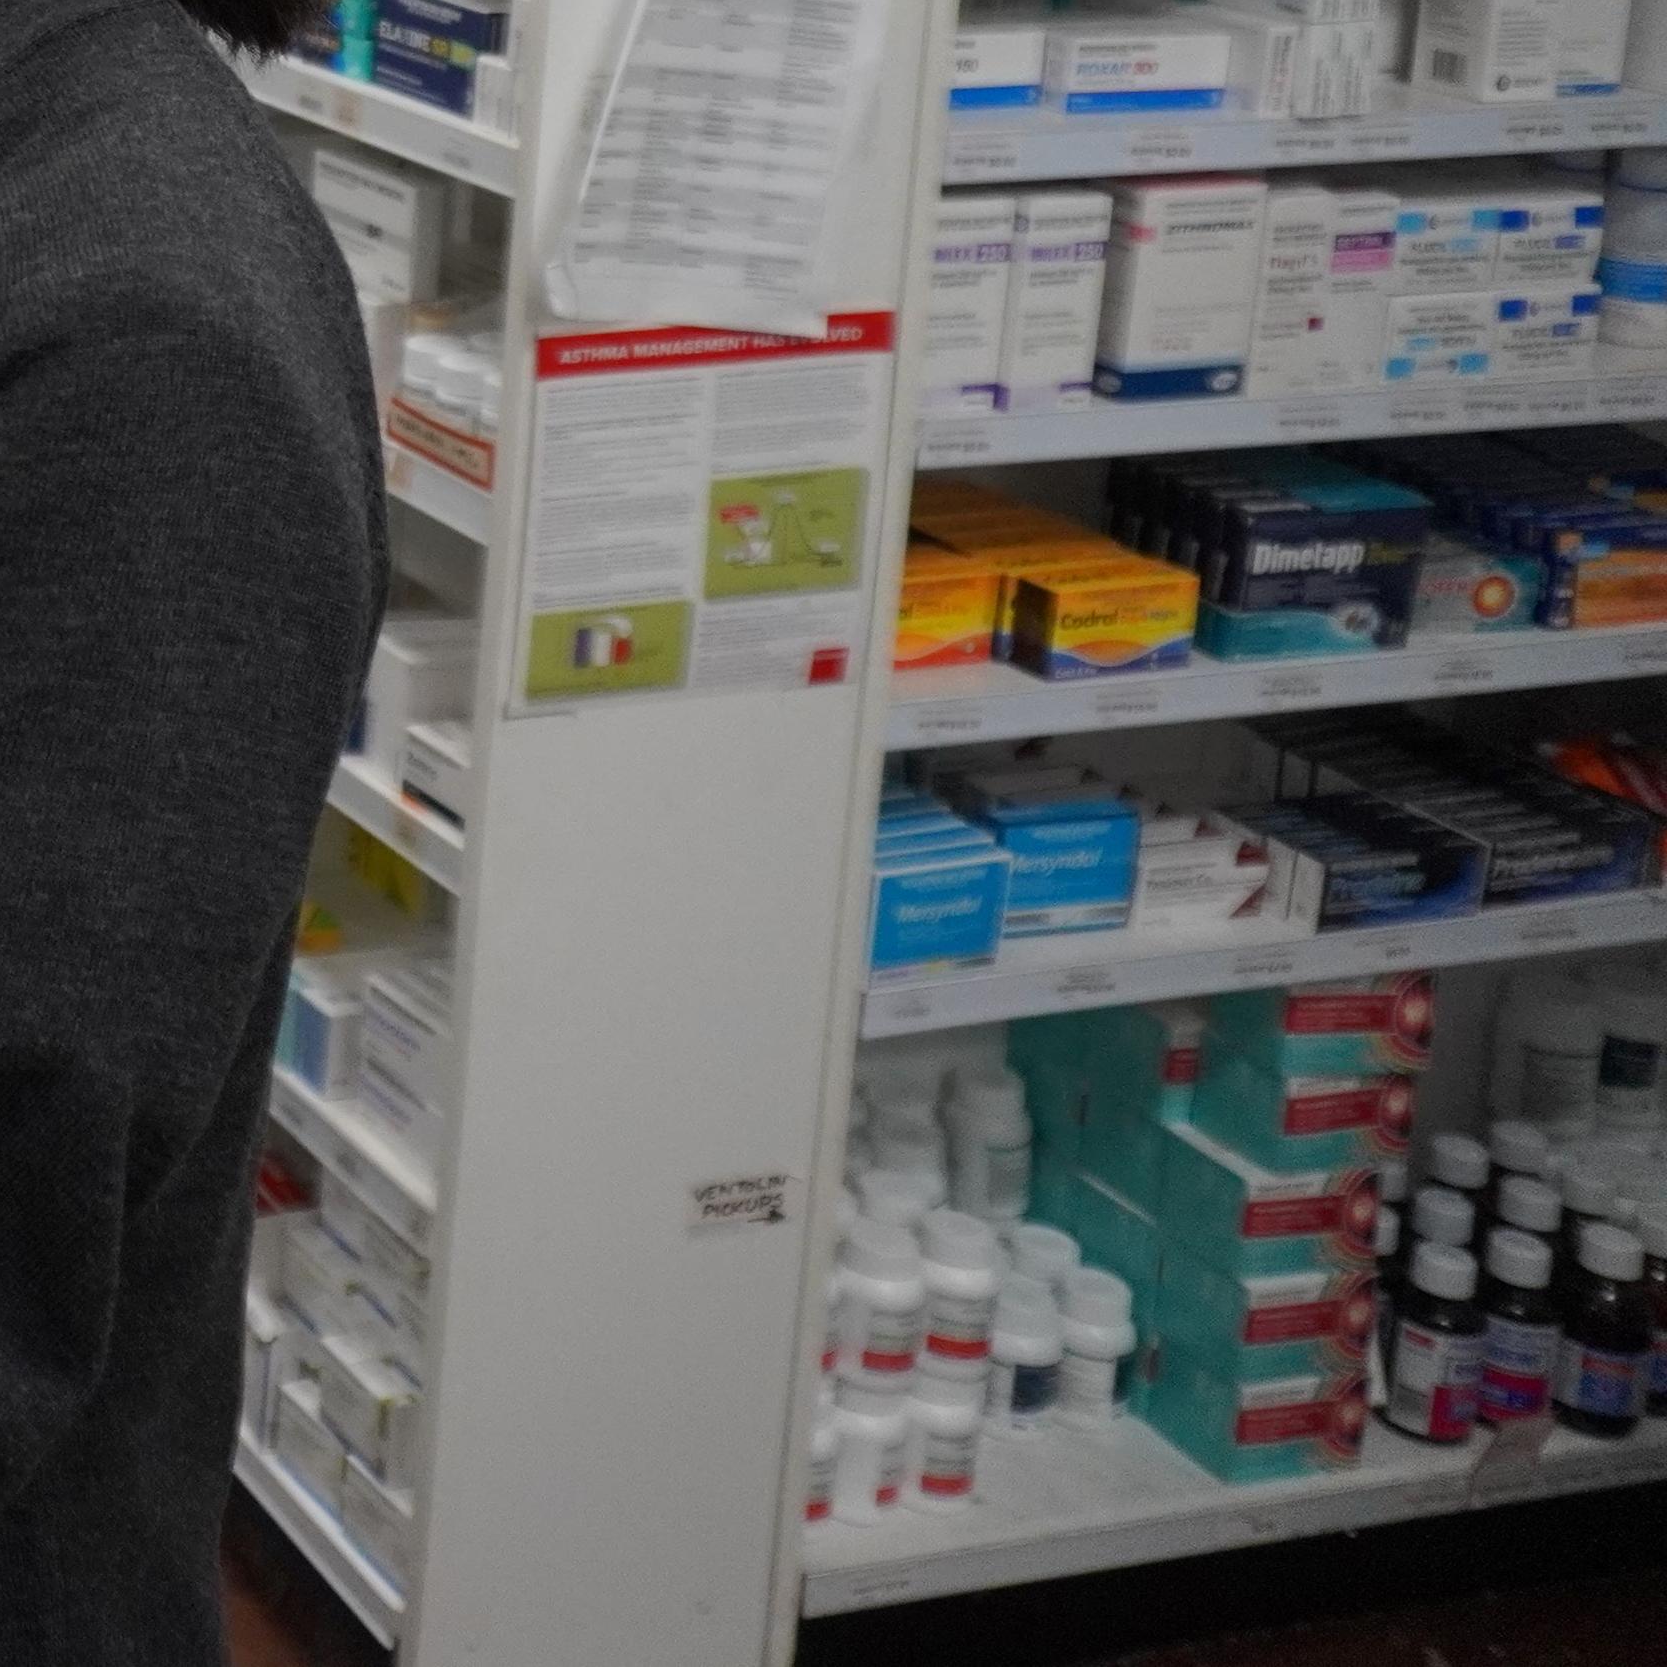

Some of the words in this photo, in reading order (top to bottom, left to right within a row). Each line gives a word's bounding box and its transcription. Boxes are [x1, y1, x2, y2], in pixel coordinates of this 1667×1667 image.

[559, 345, 630, 365] ASTHMA
[633, 336, 748, 359] MANAGEMENT
[1251, 542, 1364, 575] Dimetapp
[1060, 609, 1119, 631] Codral
